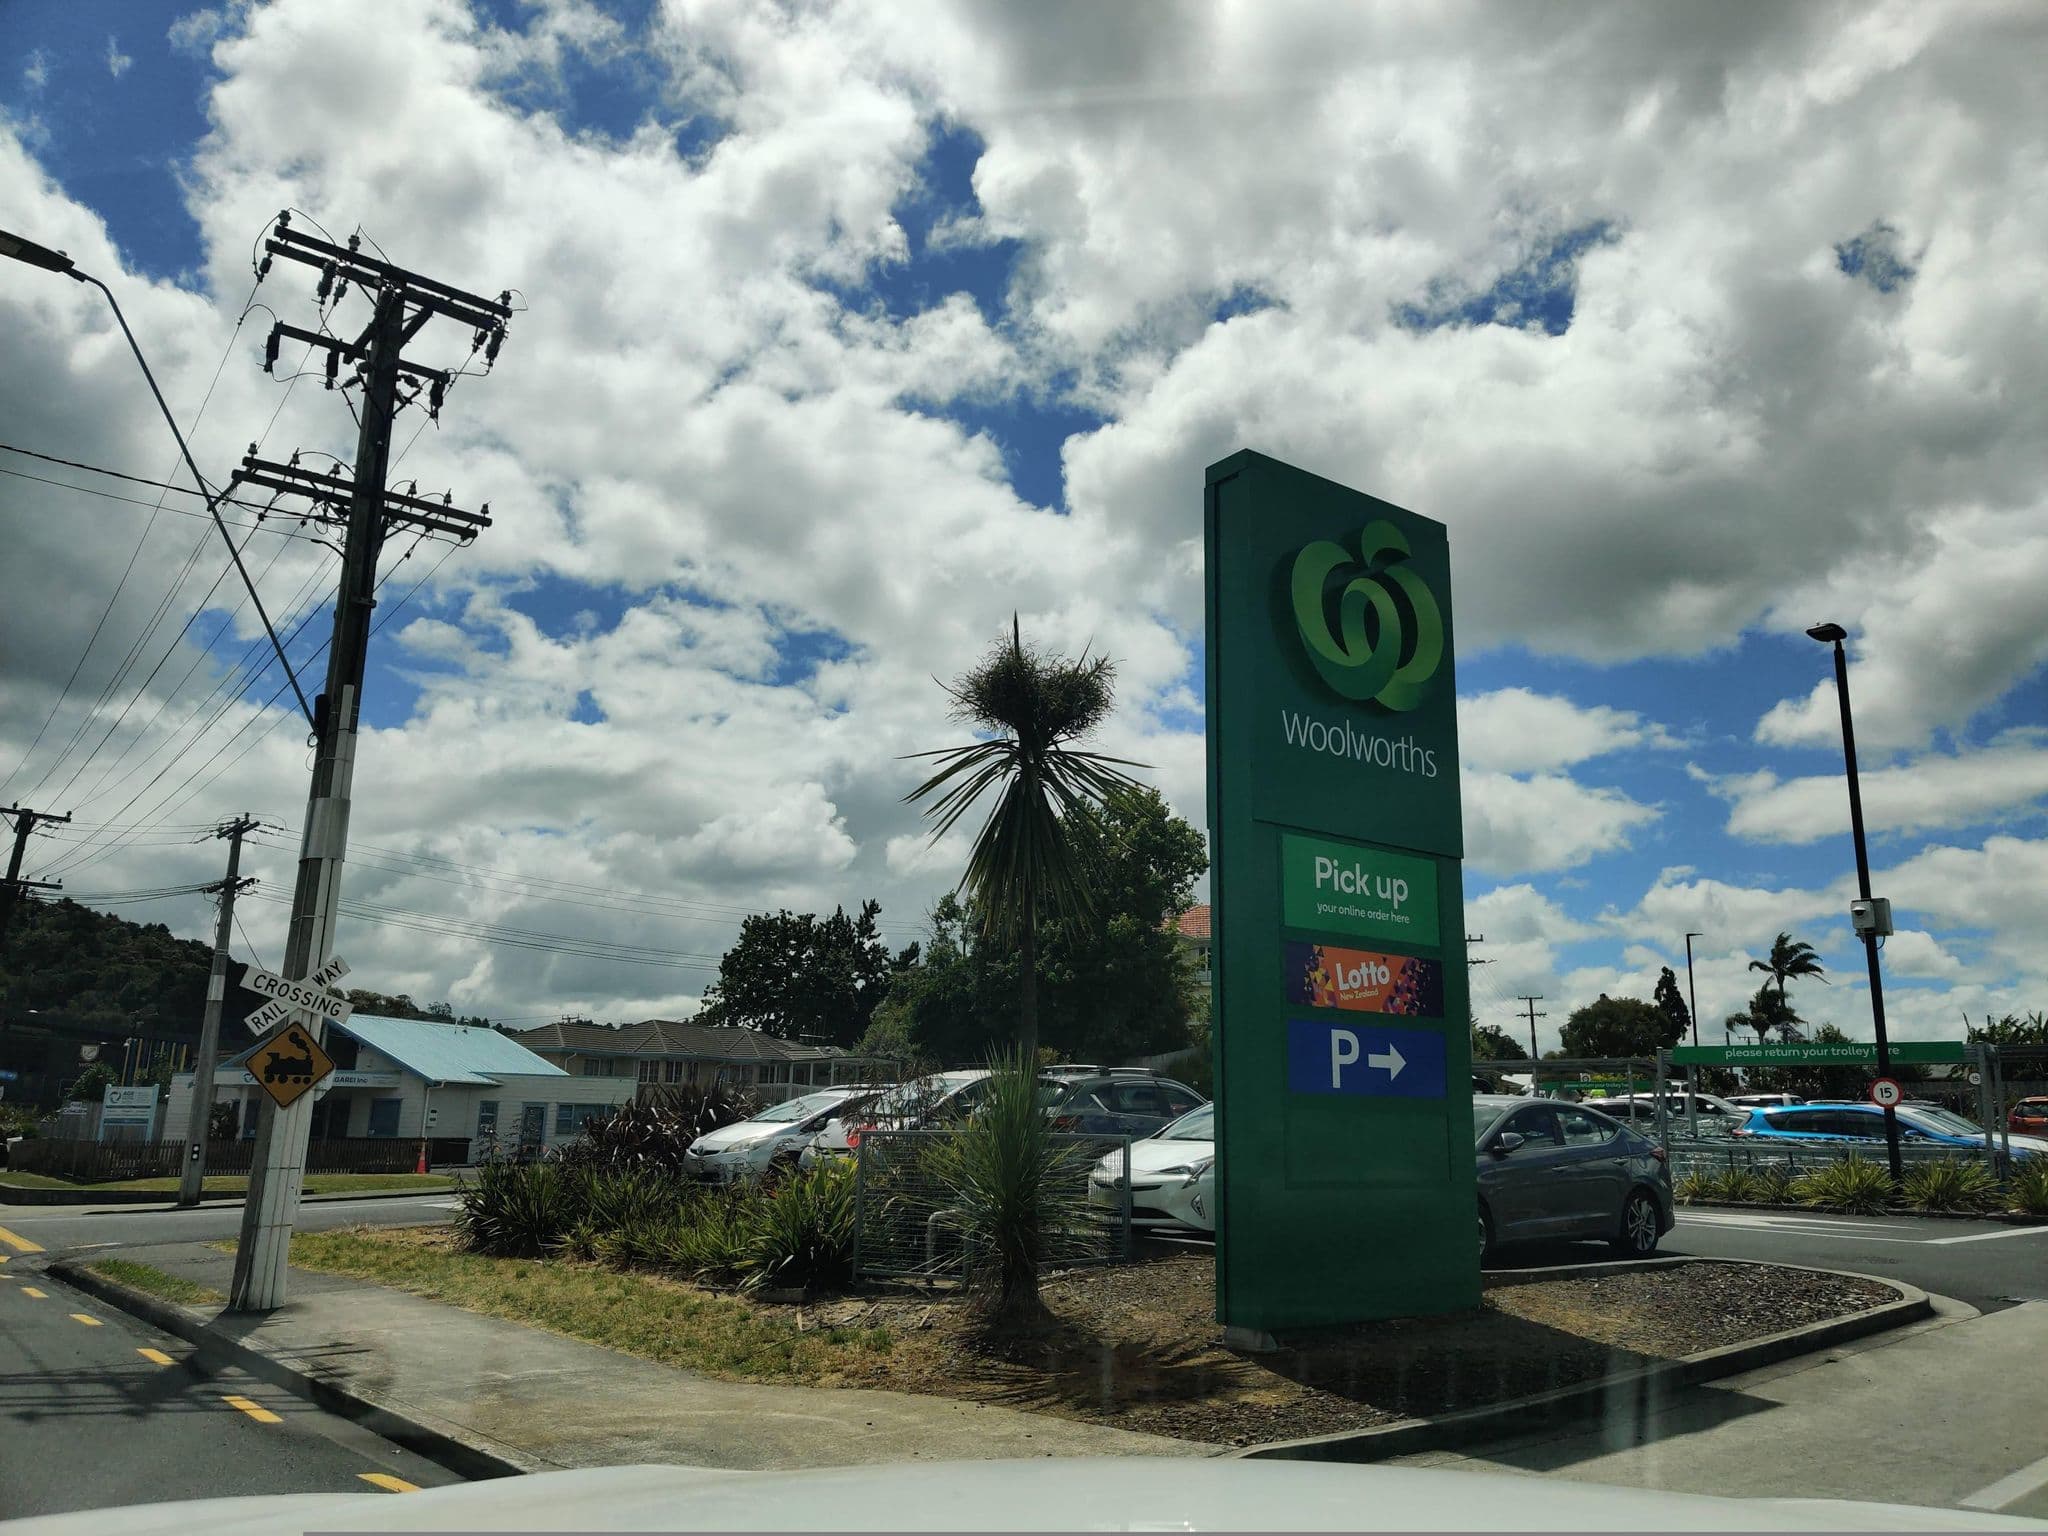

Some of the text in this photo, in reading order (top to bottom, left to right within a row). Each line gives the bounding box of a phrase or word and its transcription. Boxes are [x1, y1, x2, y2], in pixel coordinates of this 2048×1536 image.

[1282, 709, 1437, 778] Woolworths
[1315, 856, 1409, 909] Pick up
[1317, 902, 1411, 924] your online order here
[1335, 961, 1391, 991] Lotto
[251, 961, 343, 1030] RAIL WAY
[253, 974, 342, 1017] CROSSING
[1340, 989, 1379, 1001] New Zealand
[1331, 1029, 1360, 1089] P
[1725, 1045, 1900, 1060] please return your trolley hre
[1879, 1087, 1893, 1099] 15
